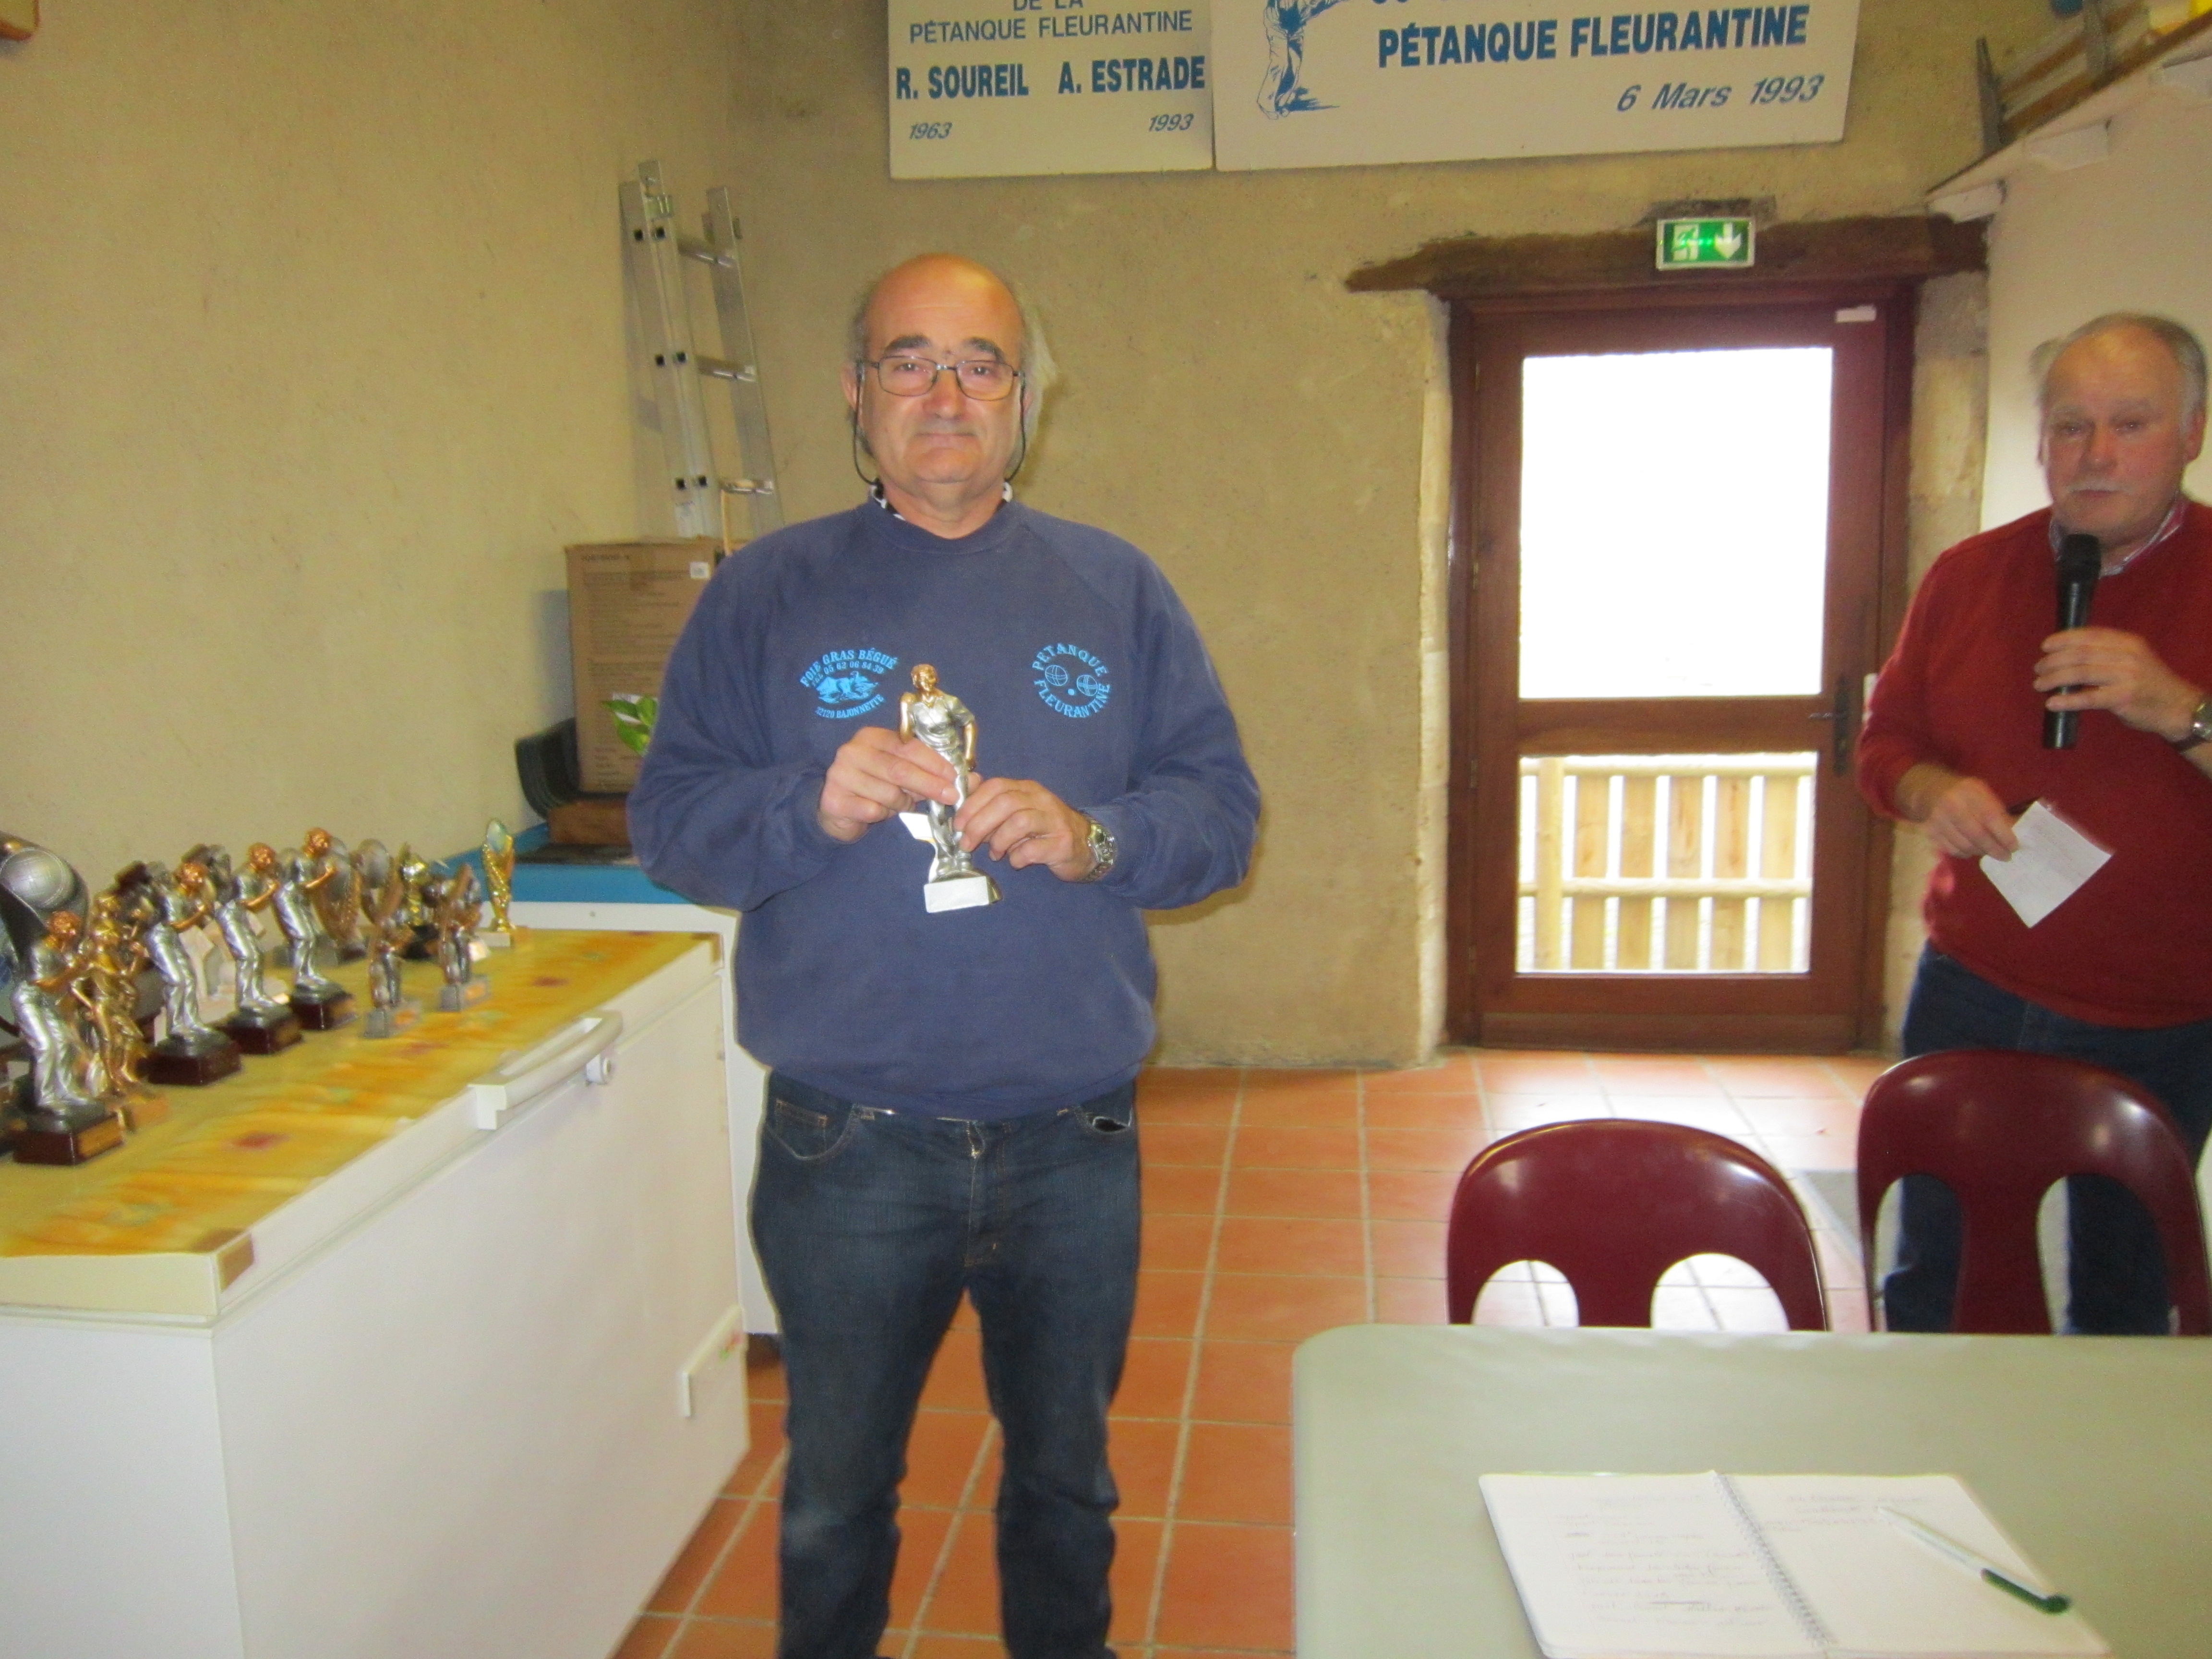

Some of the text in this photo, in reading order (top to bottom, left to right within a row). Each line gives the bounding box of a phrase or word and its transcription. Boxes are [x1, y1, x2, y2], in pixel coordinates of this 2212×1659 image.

[910, 10, 1193, 43] PÉTANQUE FLEURANTINE
[1379, 5, 1810, 68] PÉTANQUE FLEURANTINE
[896, 56, 1205, 99] R. SOUREIL A. ESTRADE
[1617, 73, 1825, 111] 6 Mars 1993
[909, 122, 952, 139] 1963
[1148, 113, 1194, 132] 1993
[800, 661, 821, 687] FOIE
[822, 650, 854, 665] GRAS
[824, 664, 834, 674] 05
[836, 661, 846, 670] 62
[1032, 643, 1108, 676] PETANQUE
[1034, 679, 1110, 718] FLEURANTINE
